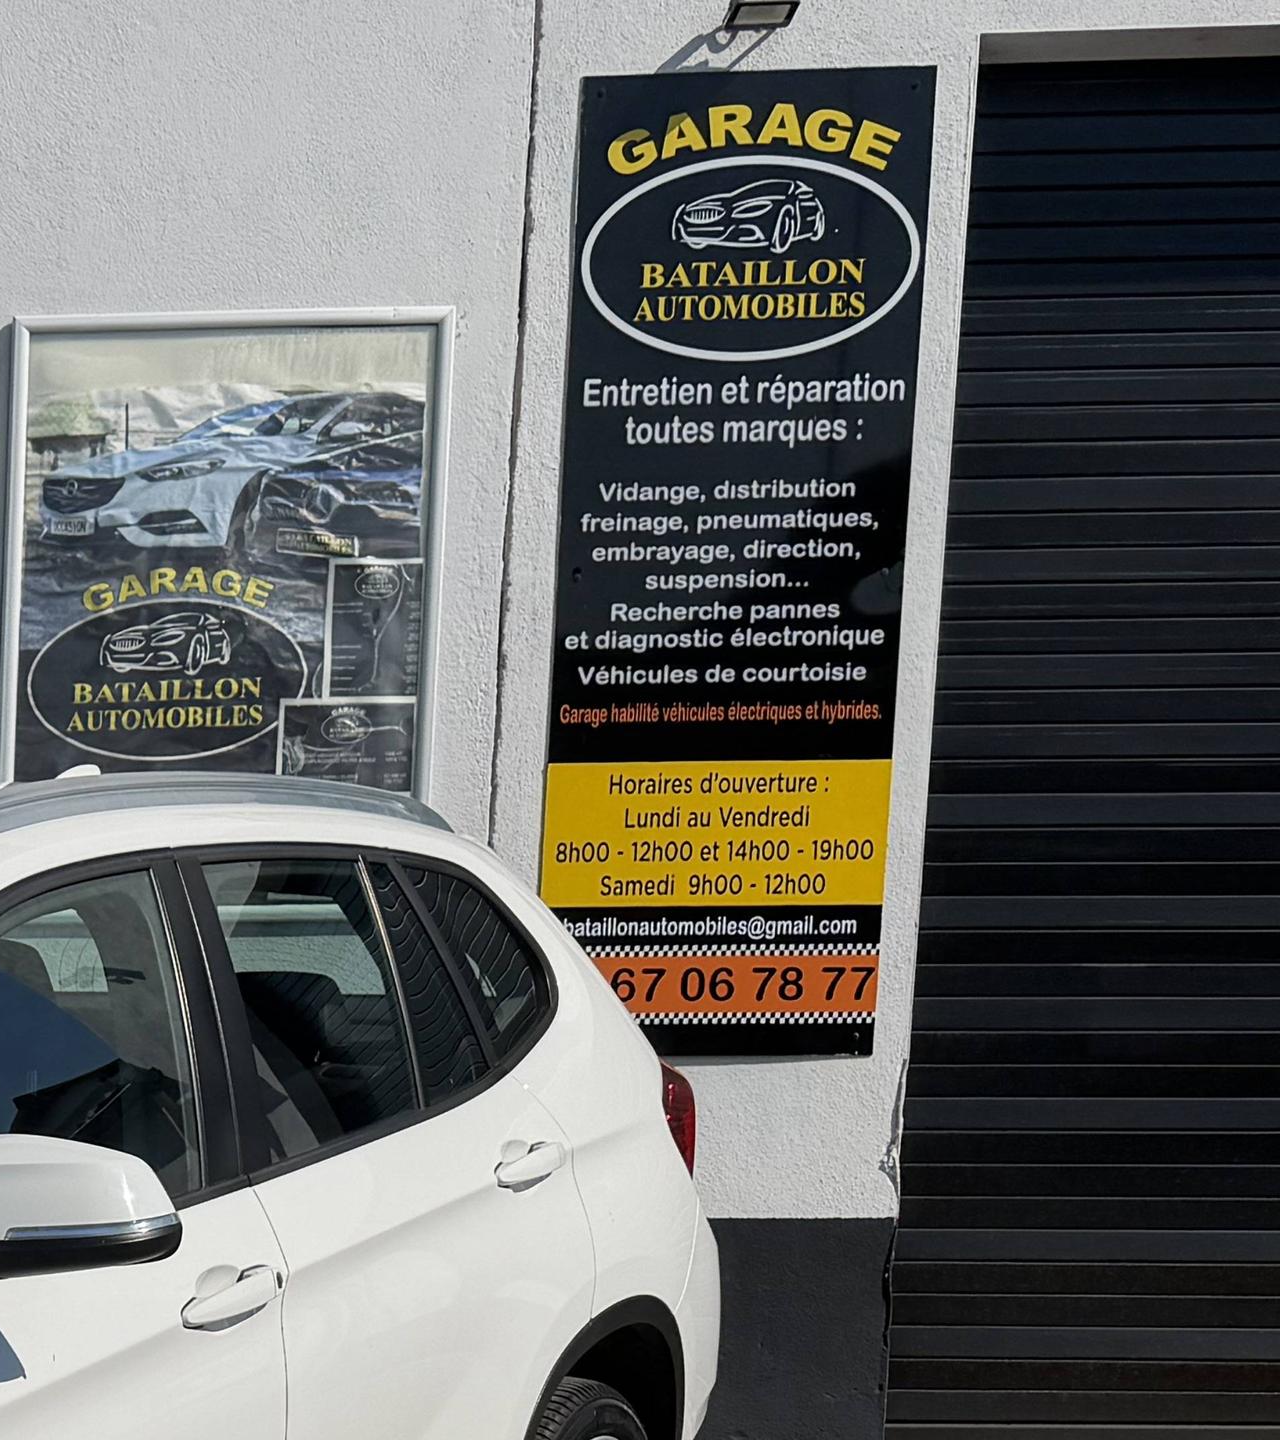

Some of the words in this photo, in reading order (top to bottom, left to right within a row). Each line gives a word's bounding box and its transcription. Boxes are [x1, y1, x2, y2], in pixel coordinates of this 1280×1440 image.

[607, 102, 902, 175] GARAGE
[639, 258, 866, 289] BATAILLON
[633, 292, 866, 323] AUTOMOBILES
[583, 376, 712, 407] Entretien
[721, 379, 749, 404] et
[756, 374, 906, 411] réparation
[625, 417, 714, 445] toutes
[723, 415, 847, 448] marques
[599, 481, 706, 503] Vidange,
[713, 478, 856, 500] distribution
[580, 512, 690, 534] freinage,
[696, 508, 879, 533] pneumatiques,
[592, 542, 736, 563] embrayage,
[743, 539, 861, 561] direction,
[82, 566, 274, 613] GARAGE
[645, 569, 809, 593] suspension...
[610, 601, 742, 622] Recherche
[750, 601, 840, 622] pannes
[564, 631, 588, 649] et
[595, 627, 723, 652] diagnostic
[730, 626, 885, 649] électronique
[578, 663, 697, 685] Véhicules
[705, 663, 735, 683] de
[742, 660, 867, 683] courtoisie
[72, 676, 262, 705] BATAILLON
[67, 704, 263, 732] AUTOMOBILES
[560, 703, 607, 728] Garage
[610, 701, 659, 724] habilité
[662, 701, 725, 722] véhicules
[728, 700, 802, 722] électriques
[806, 701, 819, 720] et
[821, 698, 882, 721] hybrides.
[608, 772, 692, 795] Horaires
[700, 770, 817, 793] d'ouverture
[624, 805, 680, 829] Lundi
[687, 810, 711, 828] au
[719, 804, 810, 828] Vendredi
[555, 840, 610, 863] 8h00
[631, 839, 694, 862] 12h00
[700, 842, 720, 861] et
[727, 838, 790, 861] 14h00
[811, 838, 874, 860] 19h00
[600, 873, 674, 896] Samedi
[688, 873, 742, 895] 9h00
[764, 872, 826, 894] 12h00
[564, 914, 857, 939] bataillonautomobiles@gmail.com
[610, 966, 666, 1003] 67
[680, 966, 735, 1002] 06
[752, 965, 804, 1001] 78
[821, 965, 878, 1000] 77
